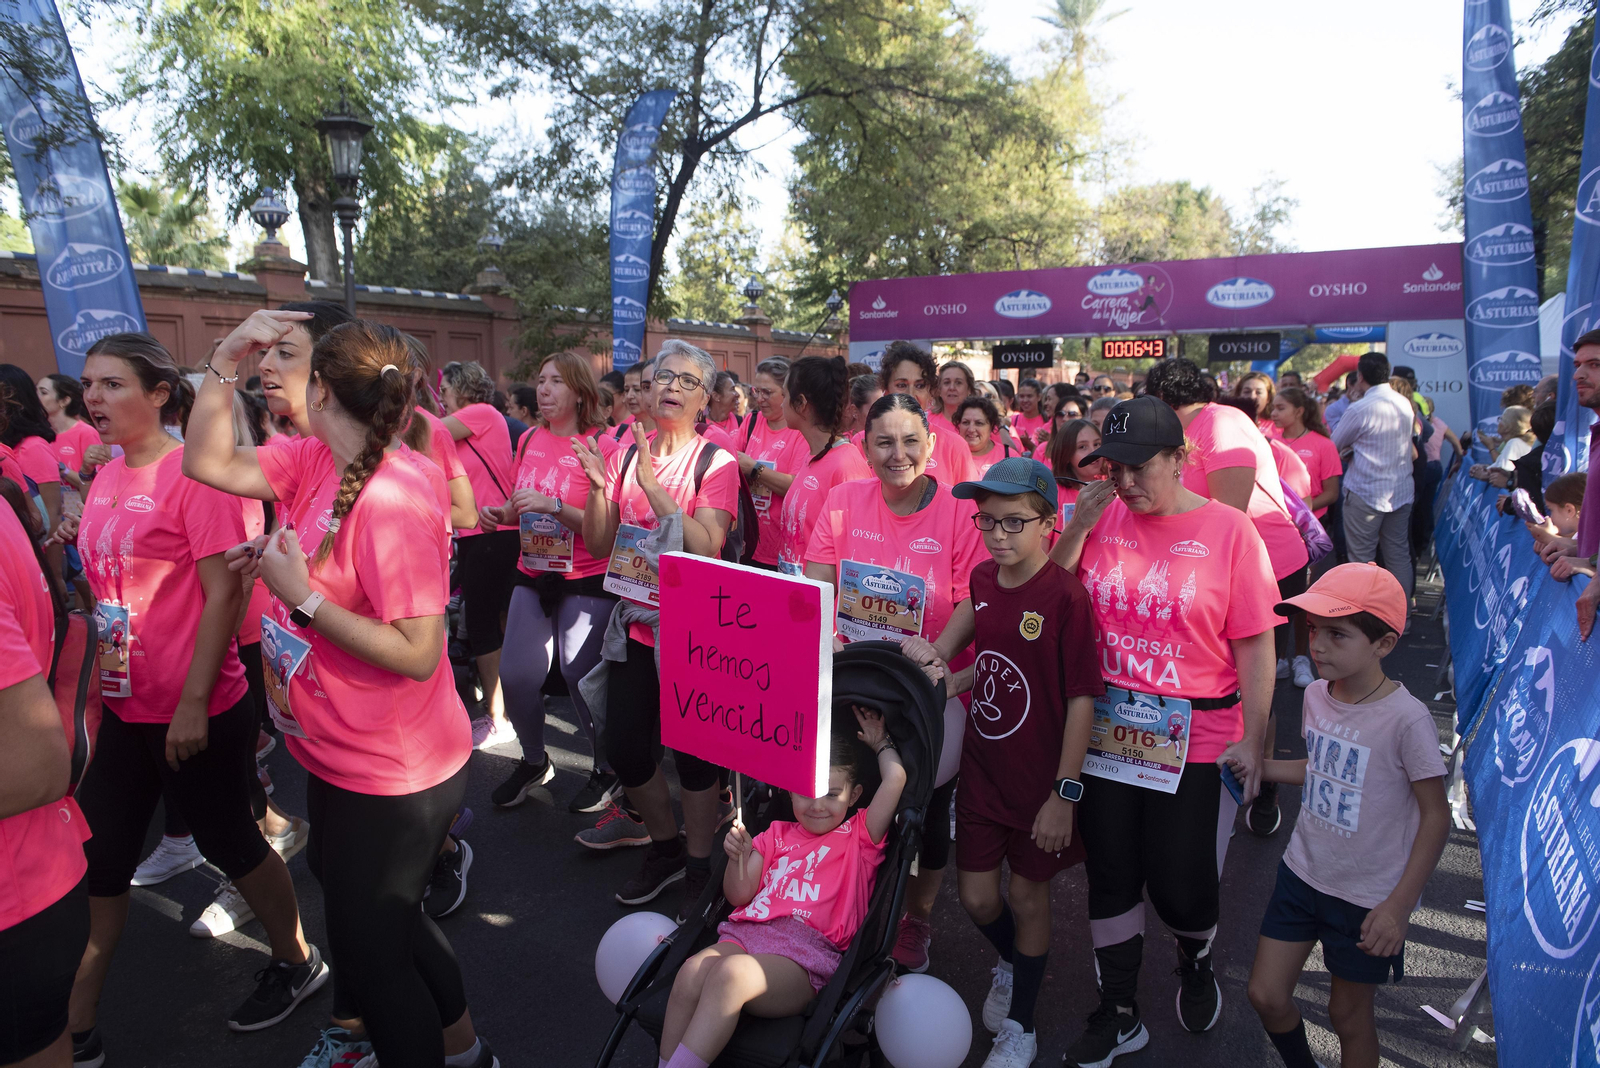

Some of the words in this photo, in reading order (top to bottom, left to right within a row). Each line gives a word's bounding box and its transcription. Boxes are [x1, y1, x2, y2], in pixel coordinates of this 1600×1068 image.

[614, 266, 648, 277] STURIANA
[1090, 279, 1141, 292] ASTURIANA
[1308, 282, 1368, 298] OYSHO
[1403, 281, 1462, 294] Santander
[1080, 294, 1129, 310] Carrera
[1211, 289, 1269, 302] ASTURIANA
[923, 303, 967, 316] OYSHO
[998, 301, 1048, 313] ASTURIANA
[613, 309, 644, 320] TURIANA
[859, 310, 899, 320] Santander
[1092, 310, 1101, 320] de
[1102, 309, 1110, 320] la
[1108, 310, 1146, 330] Mujer
[1218, 341, 1271, 355] OYSHO
[1407, 343, 1460, 353] ASTURIANA
[1000, 351, 1045, 364] OYSHO
[1417, 380, 1463, 394] YSHO
[1105, 412, 1130, 436] M
[532, 535, 554, 547] 016
[852, 528, 885, 542] OYSHO
[911, 542, 940, 552] ASTURIANA
[1099, 535, 1138, 550] OYSHO
[1172, 546, 1206, 556] ASTURIANA
[635, 572, 652, 582] 2189
[864, 578, 900, 593] ASTURIANA
[710, 585, 757, 629] te
[861, 595, 898, 615] 016
[1328, 605, 1352, 614] ARTENGO
[851, 617, 872, 627] CARRERA
[886, 625, 903, 633] MUJER
[868, 614, 888, 623] 5149
[842, 623, 866, 637] OYSHO
[1106, 631, 1185, 660] DORSAL
[688, 630, 770, 691] hemos
[1102, 648, 1182, 689] UMA
[1119, 680, 1140, 689] MUJER
[1116, 705, 1158, 721] ASTURIANA
[1113, 725, 1156, 748] 016
[1121, 747, 1144, 758] 5150
[1087, 760, 1119, 774] OYSHO
[1101, 751, 1125, 762] CARRERA
[1143, 761, 1162, 770] MUJER
[1144, 774, 1171, 785] Santander
[1560, 773, 1582, 825] CENTRAL
[1532, 763, 1591, 945] ASTURIANA
[792, 908, 812, 919] 2017
